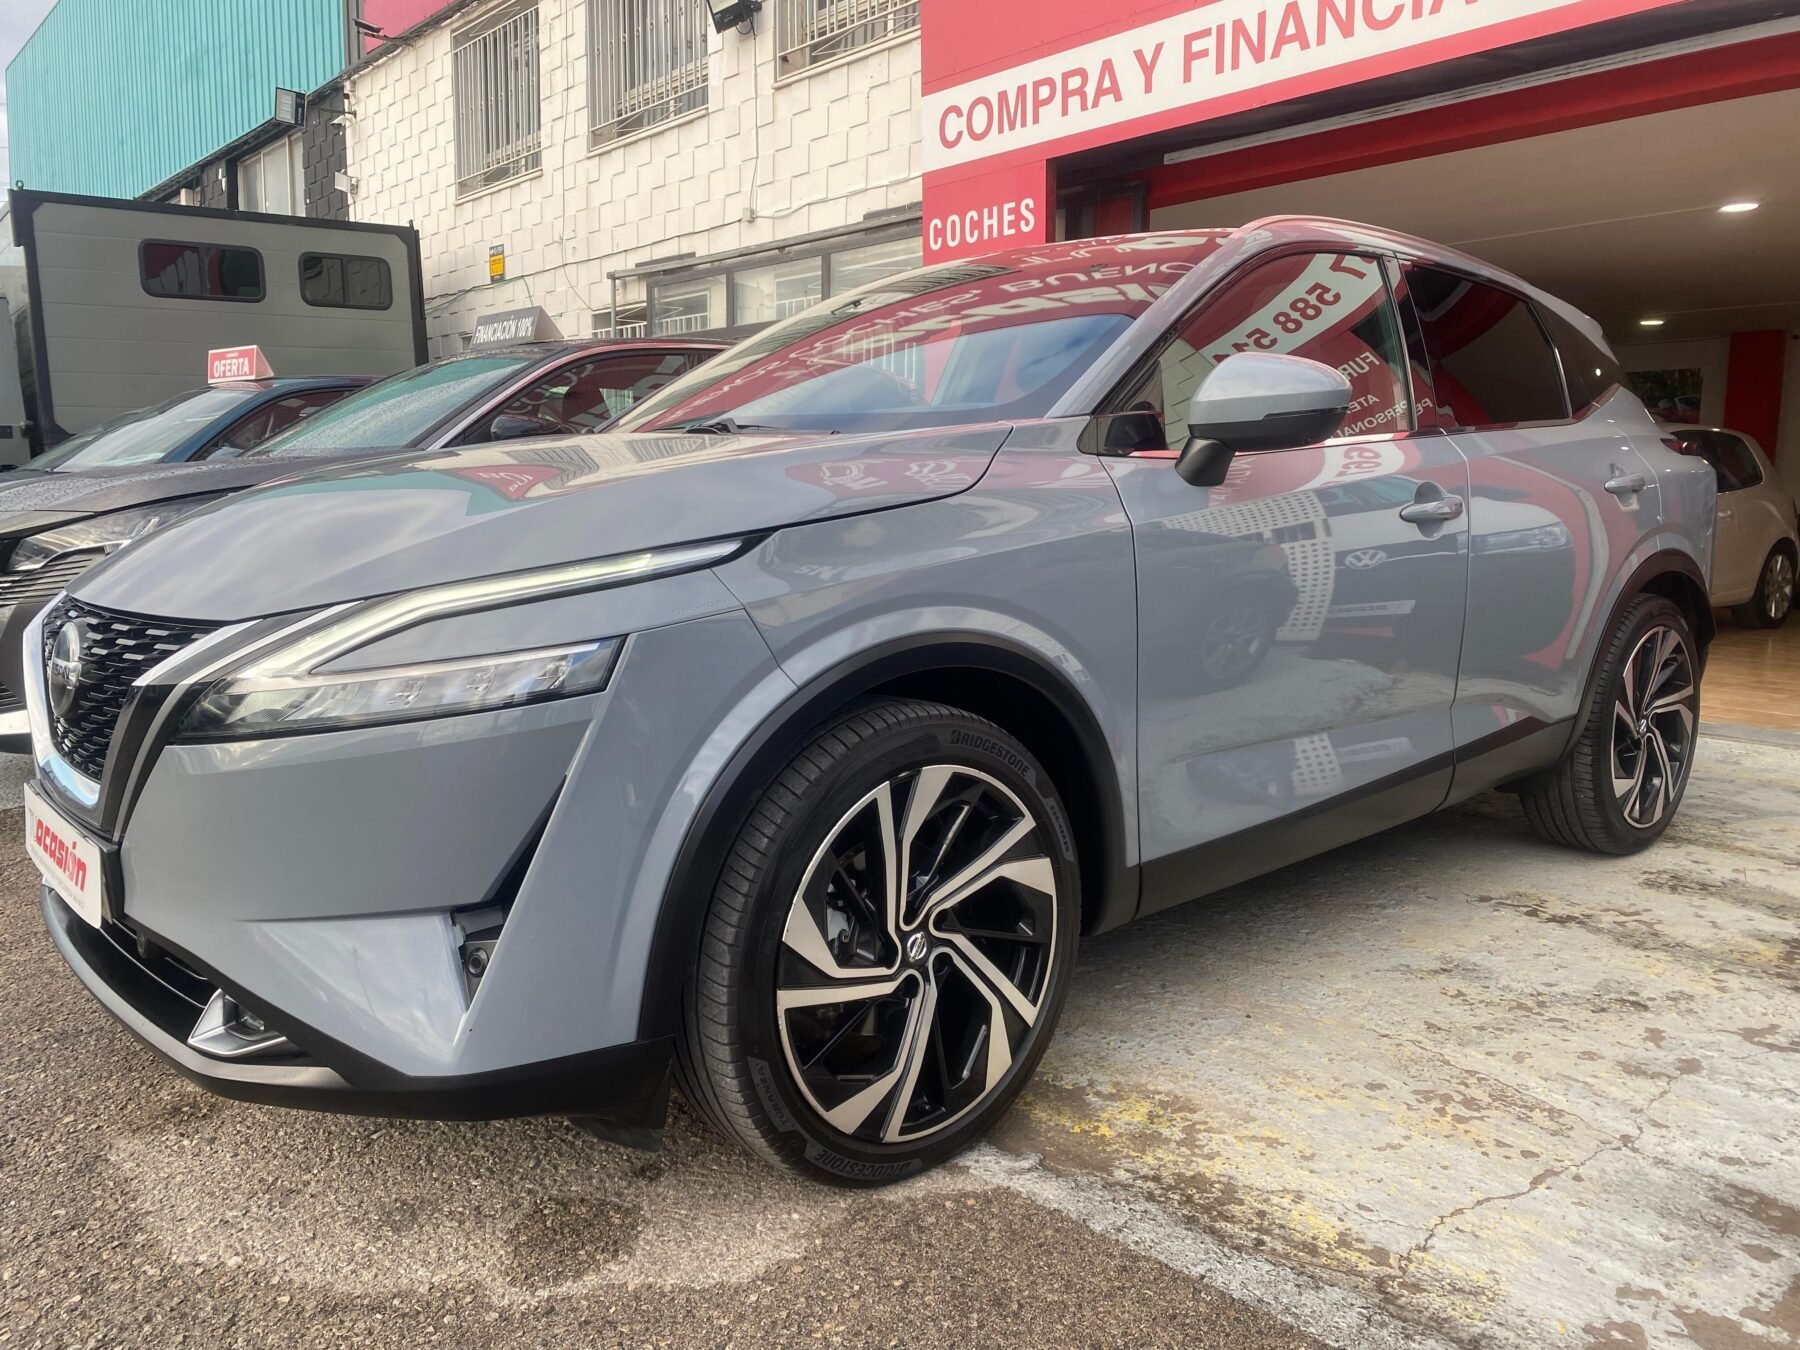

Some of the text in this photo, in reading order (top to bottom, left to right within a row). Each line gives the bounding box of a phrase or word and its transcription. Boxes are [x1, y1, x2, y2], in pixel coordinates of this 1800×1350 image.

[939, 0, 1479, 149] COMPRA Y FINANC
[929, 197, 1035, 251] COCHES
[213, 357, 250, 378] OFERTA
[950, 729, 1030, 777] BRIDGESTONE
[35, 818, 87, 892] ocasión
[814, 1150, 912, 1178] BRIDGESTONE
